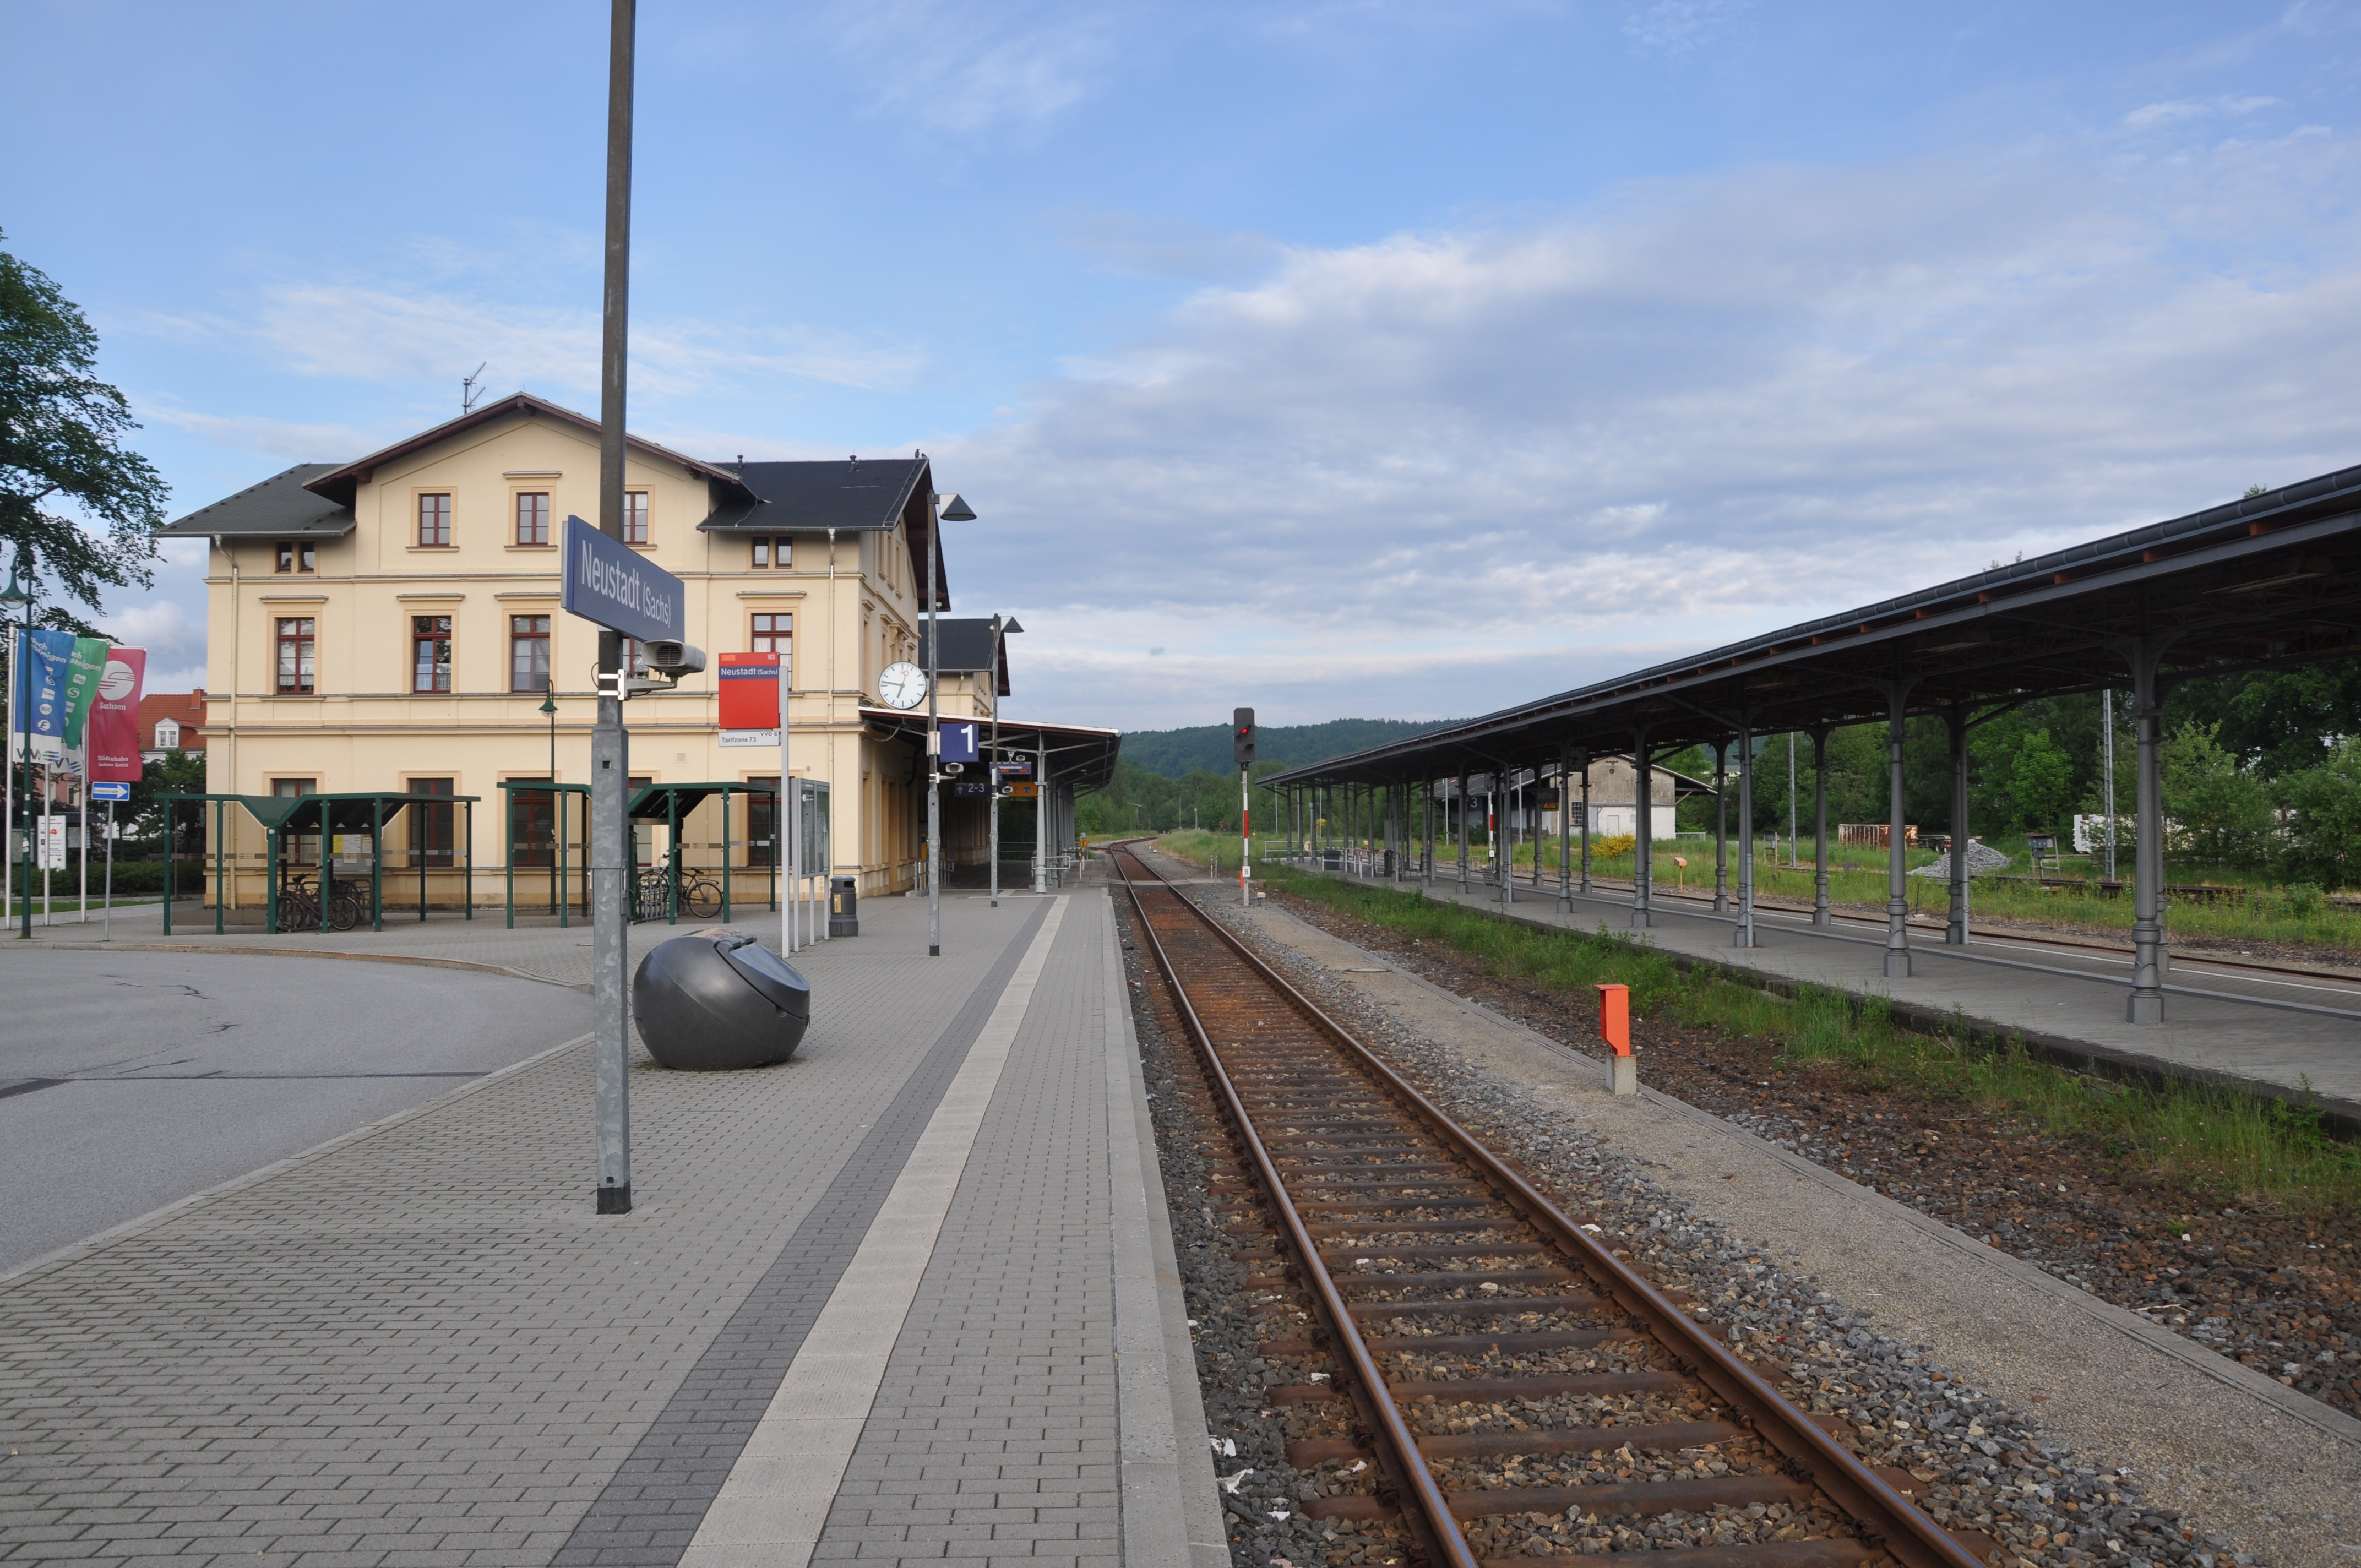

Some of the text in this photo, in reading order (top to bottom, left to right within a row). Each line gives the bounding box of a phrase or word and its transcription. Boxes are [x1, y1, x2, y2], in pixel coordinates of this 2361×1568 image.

[581, 539, 671, 629] Neustadt (Sachs)
[100, 701, 126, 710] Sachsen
[961, 724, 973, 753] 1
[968, 783, 984, 792] 2-3
[1471, 797, 1477, 808] 3
